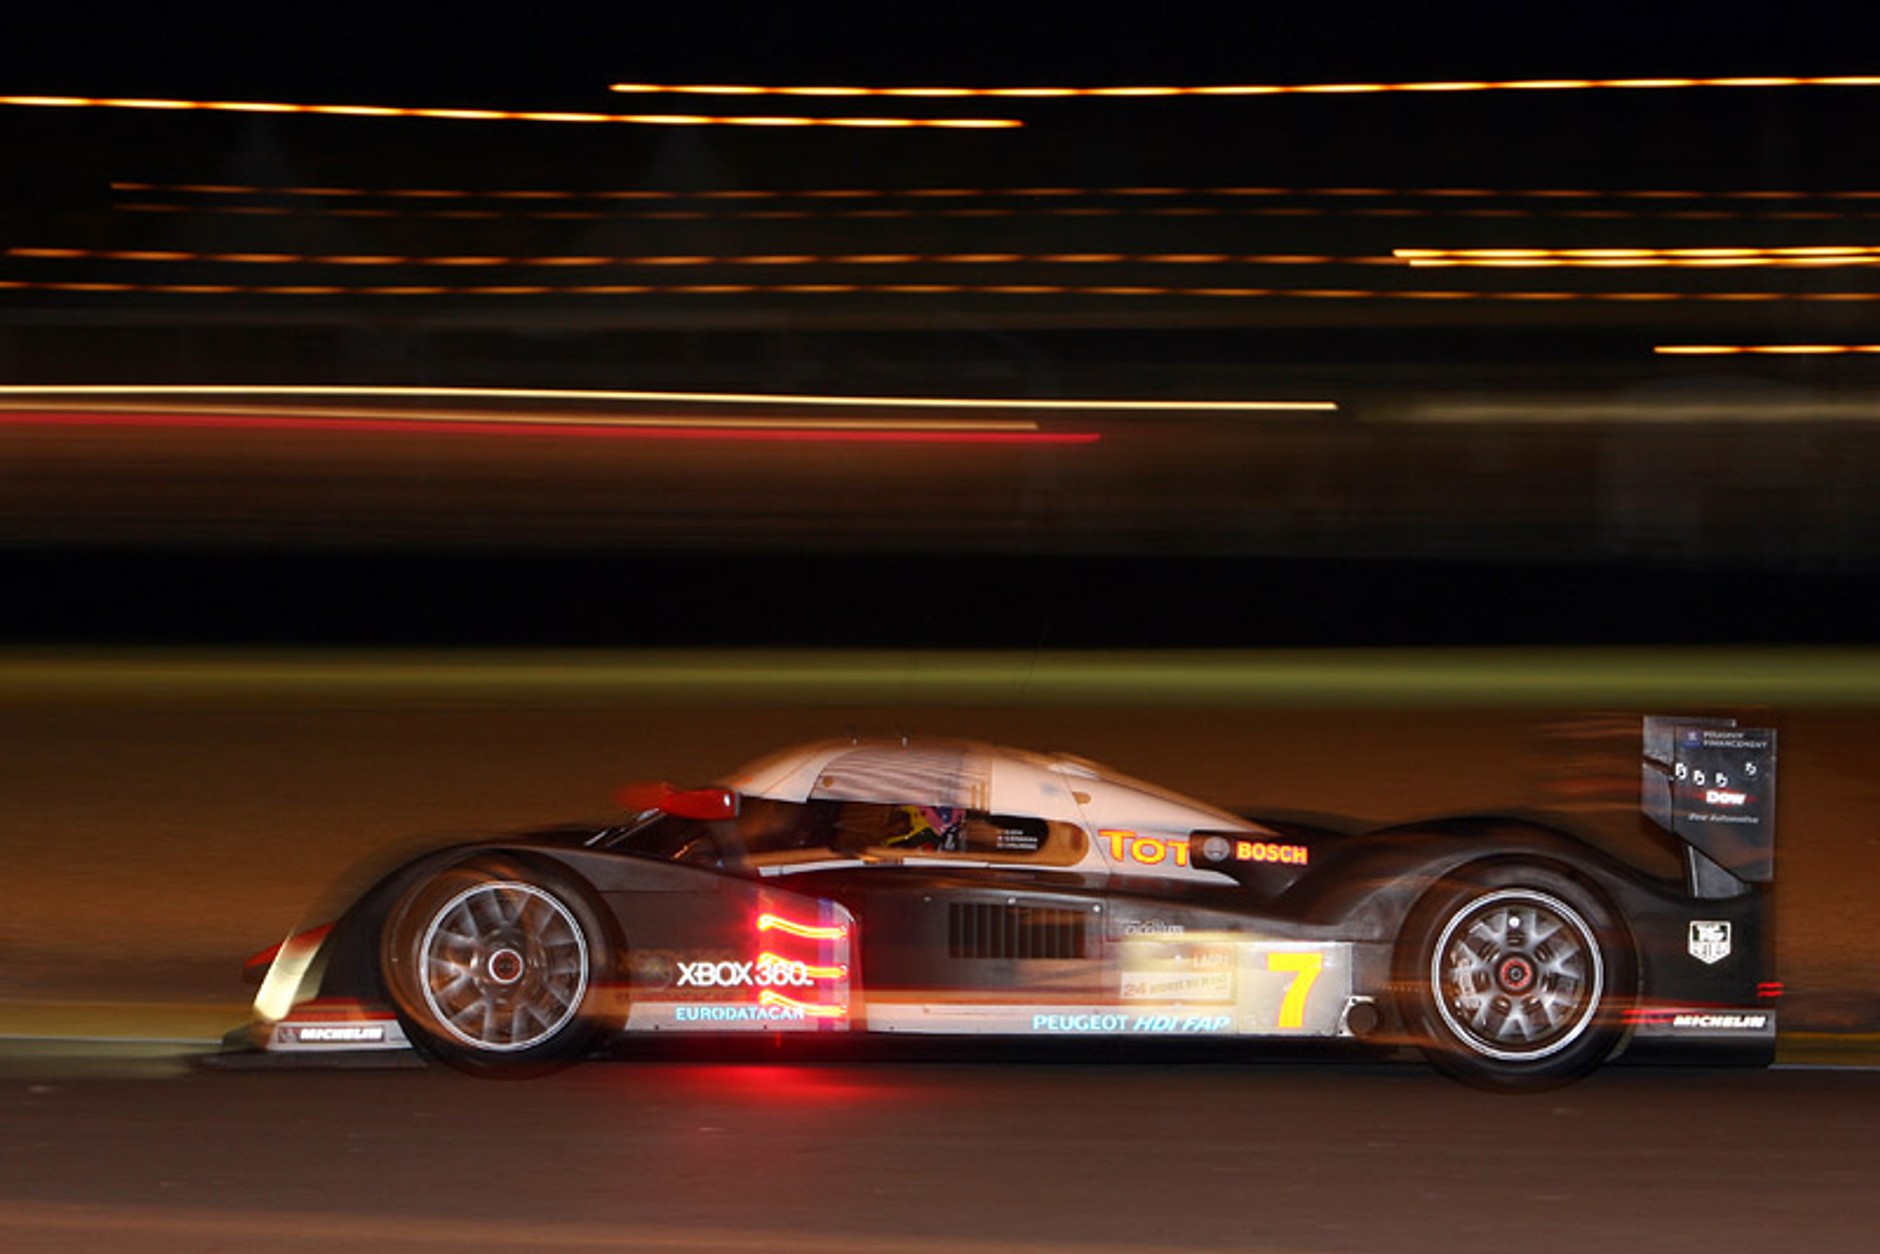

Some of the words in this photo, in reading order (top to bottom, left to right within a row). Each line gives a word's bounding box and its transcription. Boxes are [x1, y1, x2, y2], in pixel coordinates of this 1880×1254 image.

[1236, 841, 1308, 865] BOSCH
[676, 961, 753, 986] XBOX
[1266, 951, 1325, 1029] 7
[674, 1006, 804, 1021] EURODATACAR
[1673, 1014, 1766, 1028] MICHELIN
[1033, 1014, 1129, 1031] PEUGEOT
[1181, 1015, 1231, 1032] FAP
[300, 1028, 383, 1040] MICHELIN
